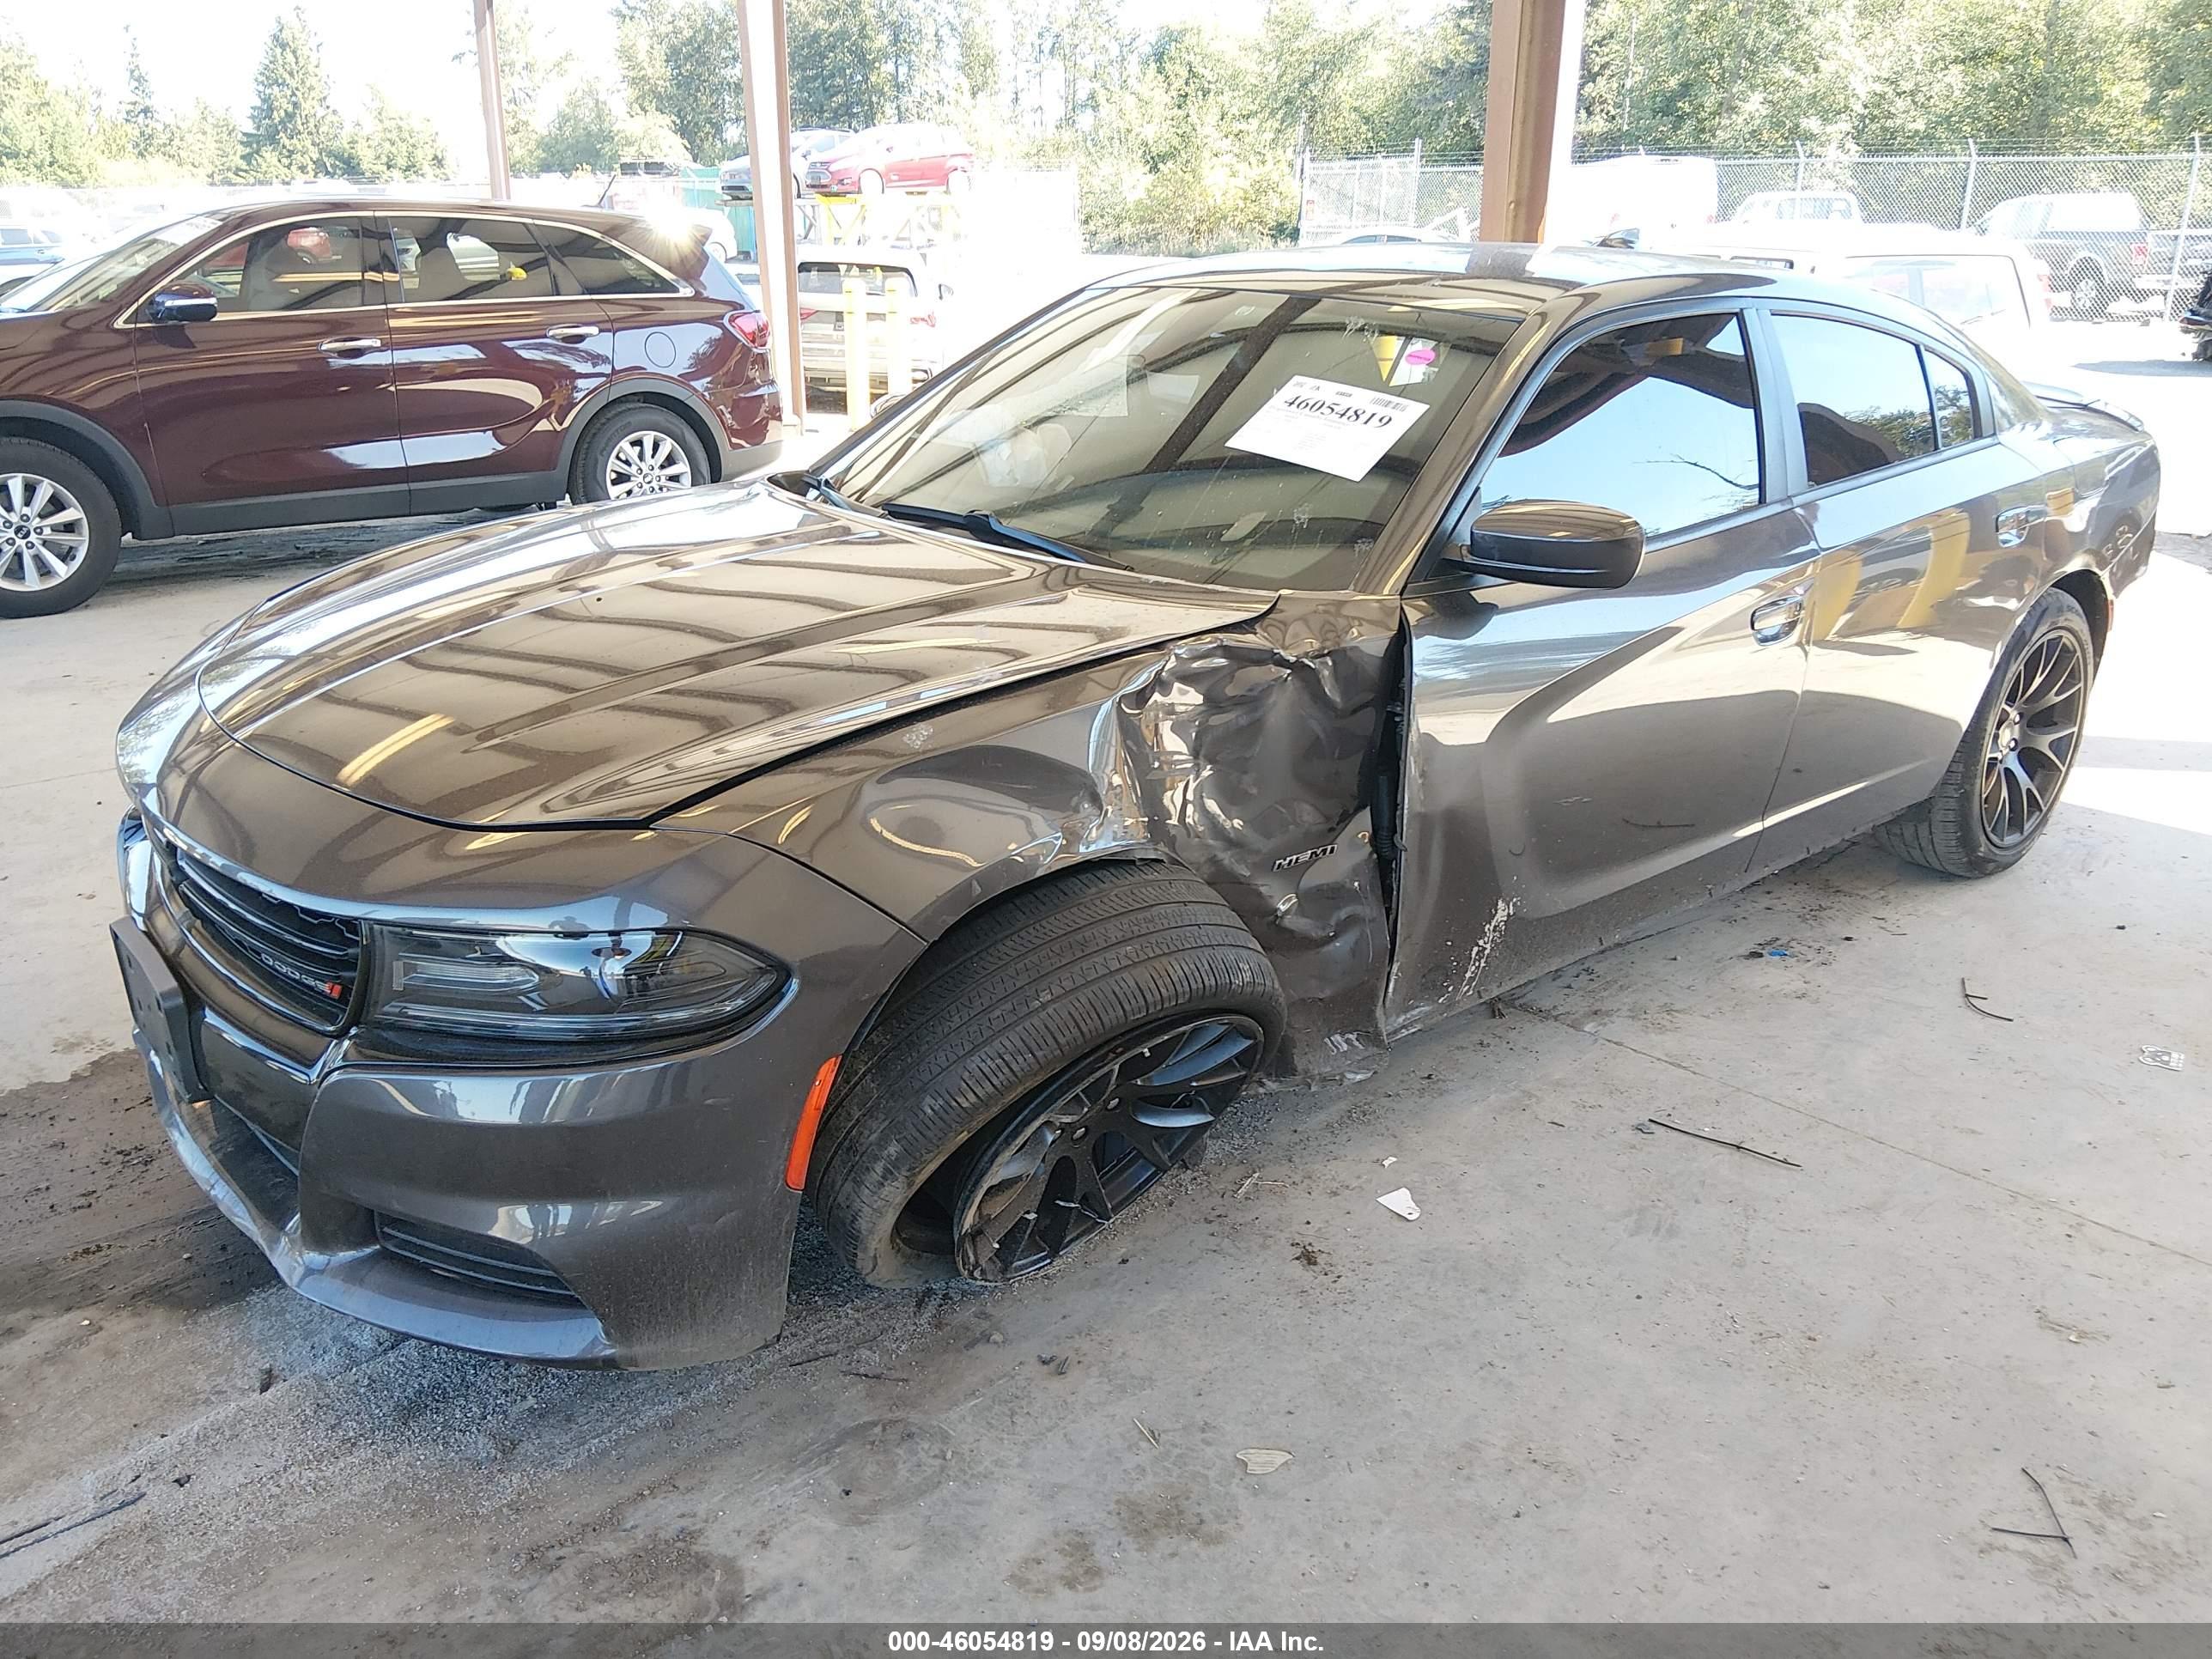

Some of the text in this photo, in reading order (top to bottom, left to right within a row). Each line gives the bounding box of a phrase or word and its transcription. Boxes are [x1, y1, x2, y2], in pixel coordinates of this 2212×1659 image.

[1284, 395, 1393, 428] 46054819
[1272, 844, 1337, 872] HEMI
[260, 952, 331, 994] DODGE
